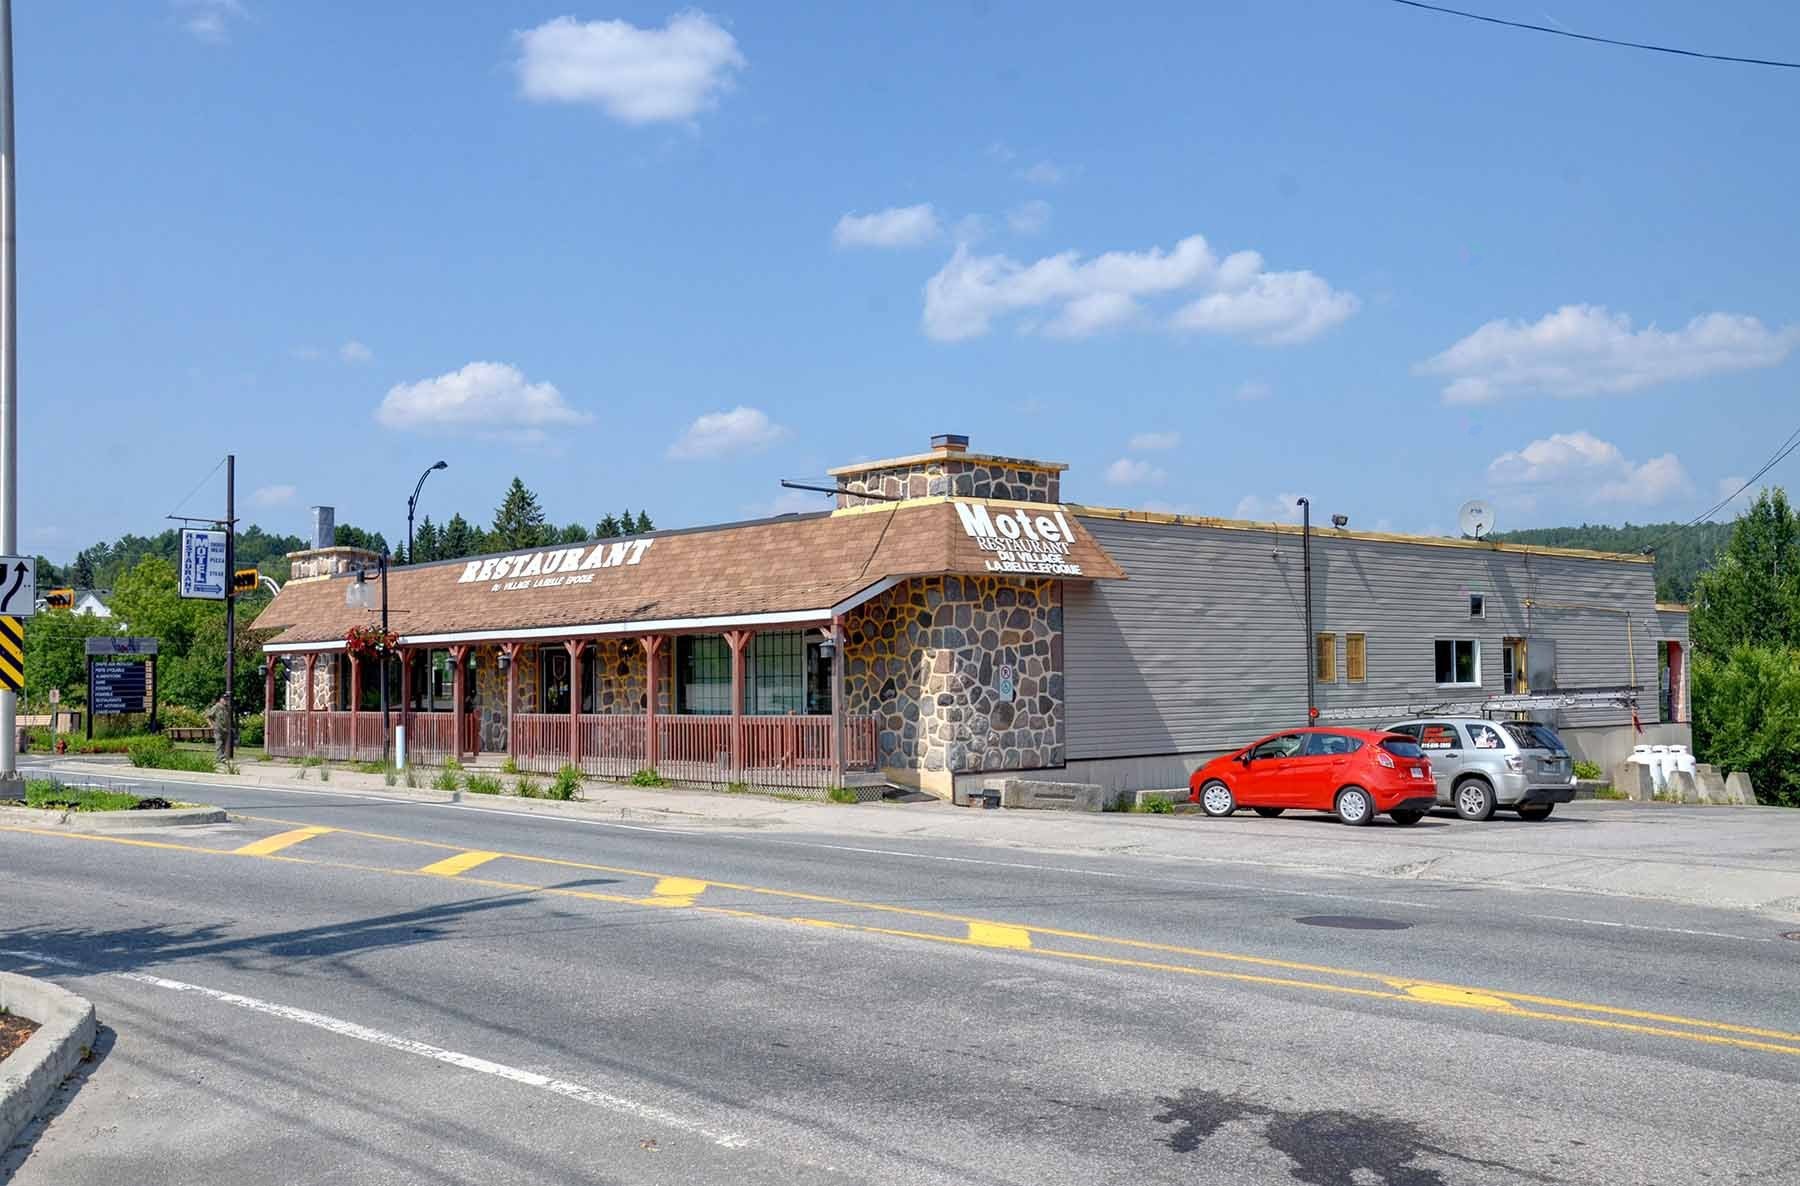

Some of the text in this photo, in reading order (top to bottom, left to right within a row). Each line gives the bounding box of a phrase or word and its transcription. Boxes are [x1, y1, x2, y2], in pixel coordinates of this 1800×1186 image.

[954, 502, 1076, 544] Motel
[184, 532, 193, 594] RESTAURANT
[195, 536, 208, 583] MOTEL
[458, 539, 655, 583] RESTAURANT
[976, 536, 1071, 555] RESTAURANT
[997, 550, 1066, 564] DU VILLAGE
[503, 579, 532, 591] VILLAGE
